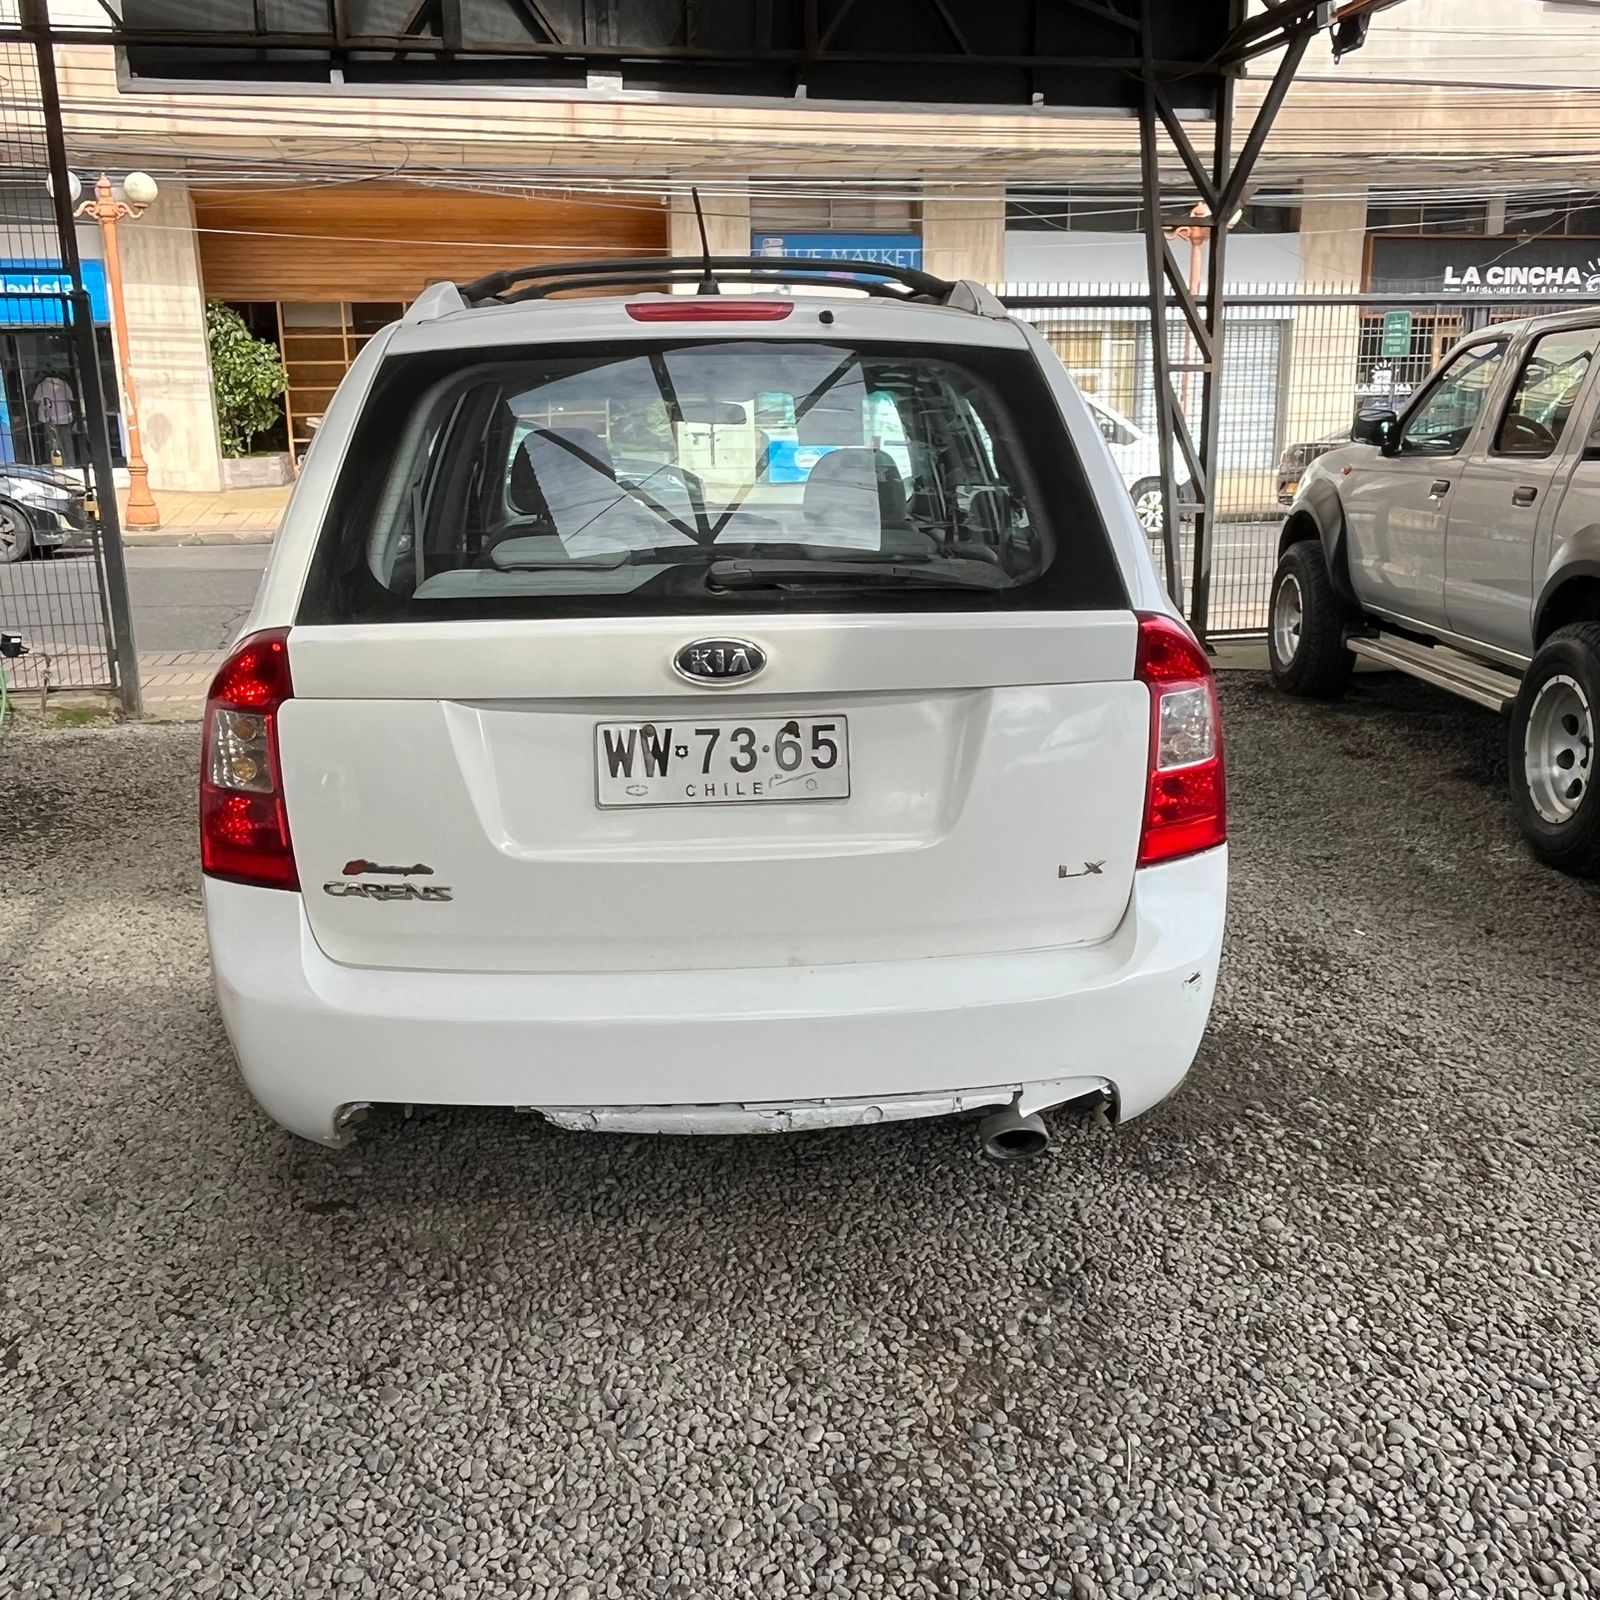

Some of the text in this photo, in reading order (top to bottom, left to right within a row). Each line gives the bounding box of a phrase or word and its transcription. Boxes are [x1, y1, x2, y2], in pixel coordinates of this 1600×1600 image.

[830, 249, 919, 267] MARKET
[1443, 266, 1582, 285] LA CINCHA
[690, 648, 752, 673] KIA
[603, 727, 673, 778] WW
[685, 782, 765, 797] CHILE
[1058, 860, 1106, 878] LX
[323, 881, 453, 901] CARENS
